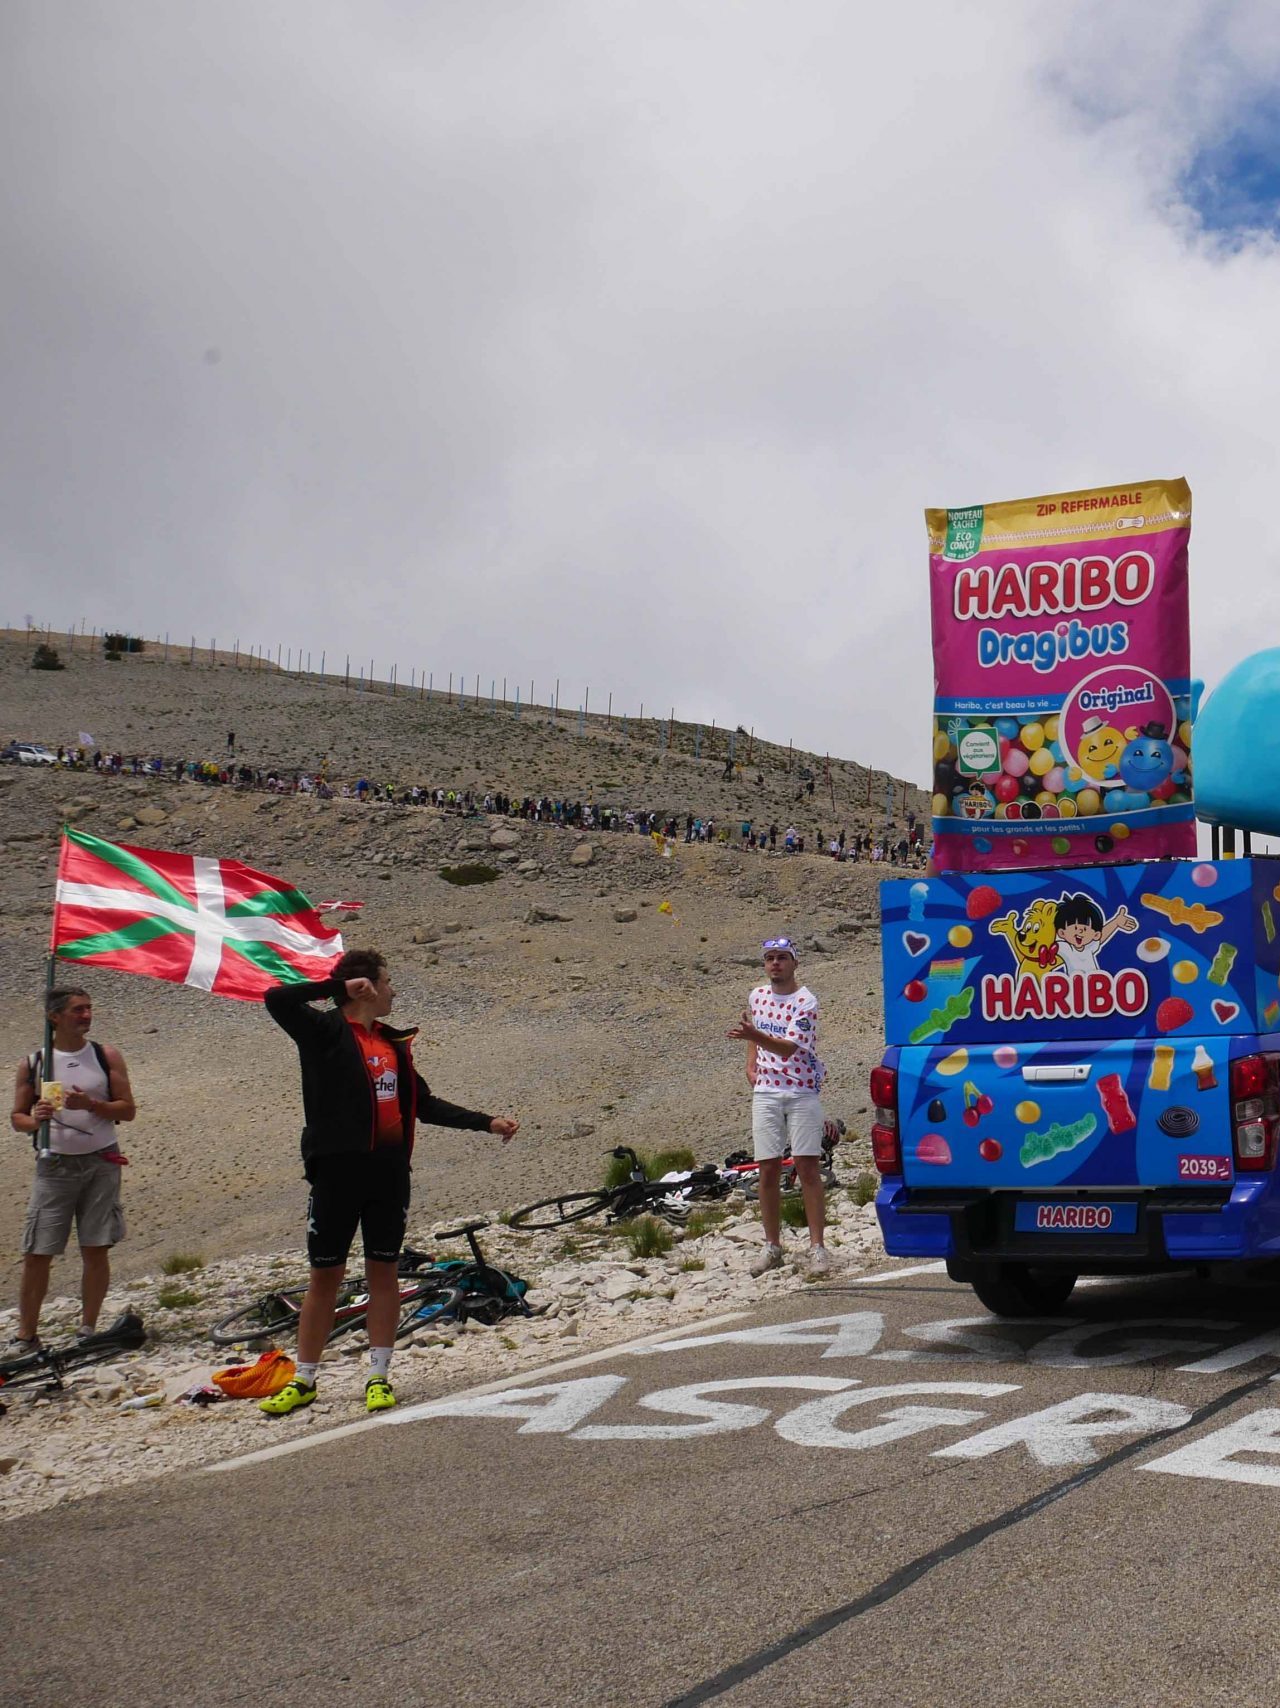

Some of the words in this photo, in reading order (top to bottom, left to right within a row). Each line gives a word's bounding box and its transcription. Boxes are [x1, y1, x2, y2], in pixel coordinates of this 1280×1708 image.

[948, 509, 982, 521] NOUVEAU
[1037, 503, 1057, 517] ZIP
[1061, 492, 1143, 515] REFERMABLE
[952, 519, 979, 530] SACHET
[955, 531, 972, 542] ECO
[954, 550, 1155, 620] HARIBO
[978, 618, 1129, 674] Dragibus
[954, 700, 983, 711] Haribo,
[985, 700, 1004, 709] c'est
[1005, 700, 1026, 709] beau
[1027, 699, 1035, 708] la
[1037, 698, 1049, 708] vie
[1080, 682, 1154, 712] Original
[971, 826, 991, 834] pour
[992, 825, 1004, 833] les
[1005, 825, 1033, 834] grands
[1045, 824, 1057, 832] les
[981, 967, 1149, 1022] HARIBO
[1181, 1158, 1218, 1176] 2039
[1036, 1205, 1113, 1229] HARIBO
